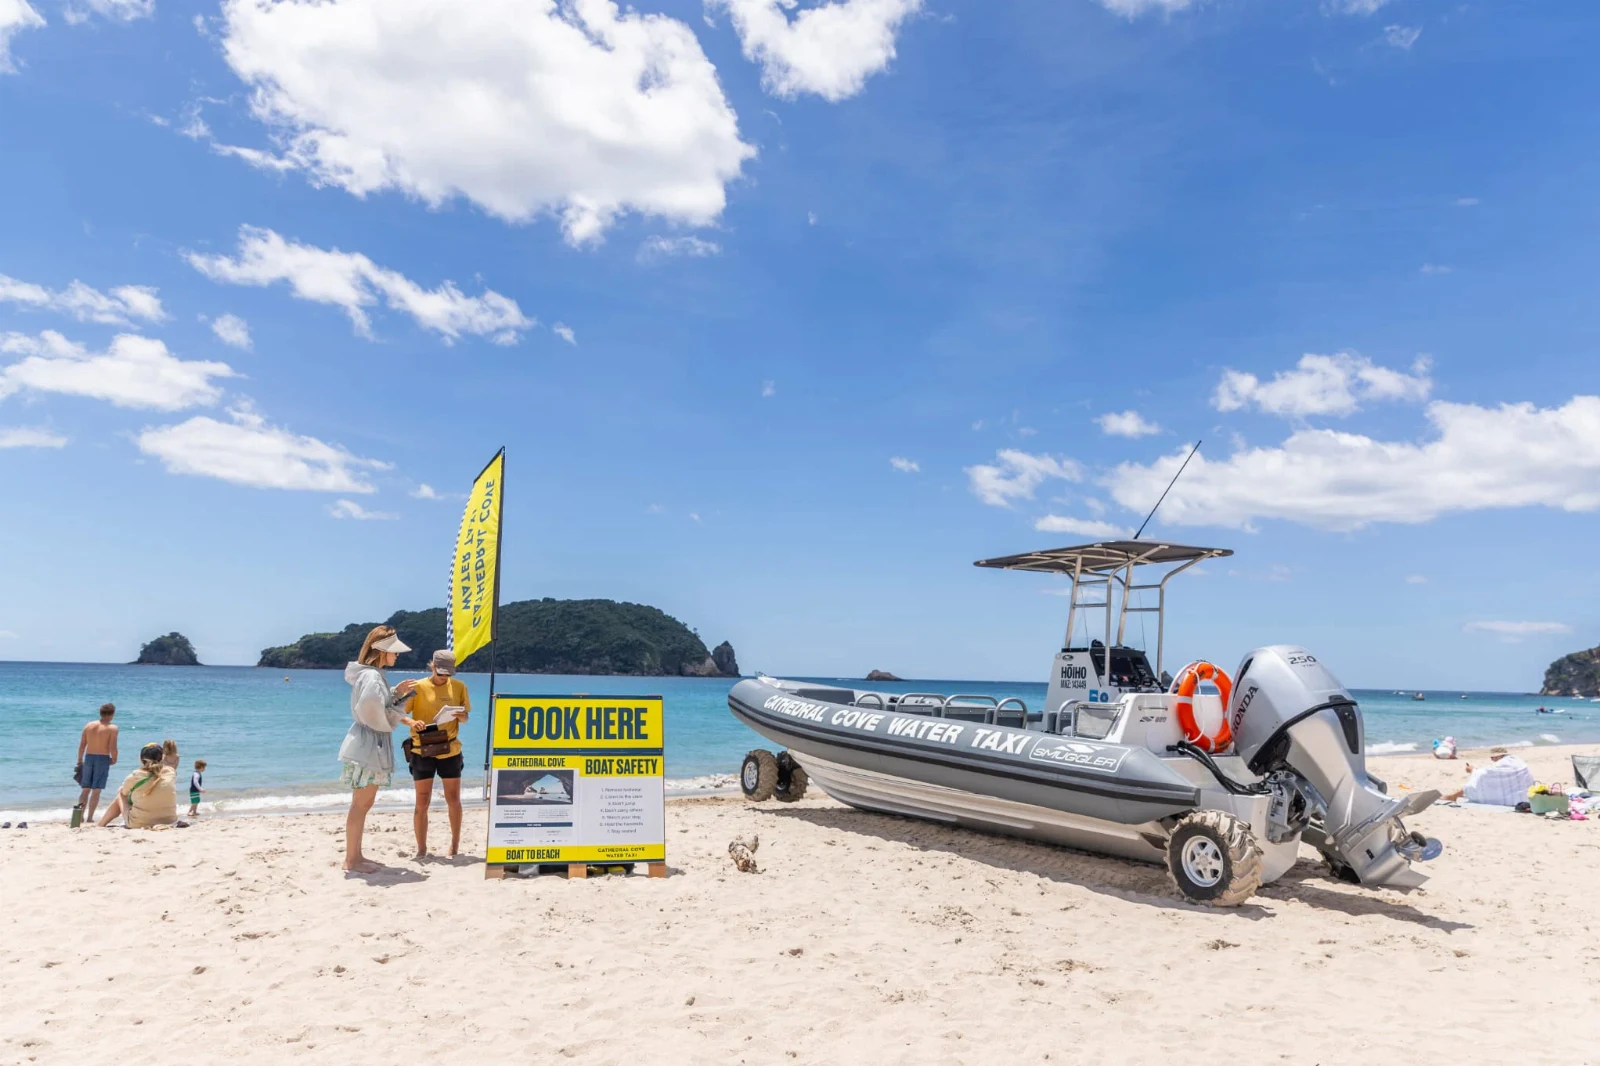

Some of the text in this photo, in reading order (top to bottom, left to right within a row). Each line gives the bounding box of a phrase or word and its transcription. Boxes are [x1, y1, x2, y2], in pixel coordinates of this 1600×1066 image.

[1288, 656, 1316, 664] 250
[1061, 664, 1086, 679] HŌIHO
[1232, 686, 1259, 736] HONDA
[508, 706, 648, 740] BOOK HERE
[764, 695, 1032, 754] CATHEDRAL COVE WATER TAXI
[508, 757, 566, 767] CATHEDRAL COVE
[586, 758, 658, 775] BOAT SAFETY
[1033, 748, 1117, 768] SMUGGLER
[506, 848, 560, 860] BOAT TO BEACH
